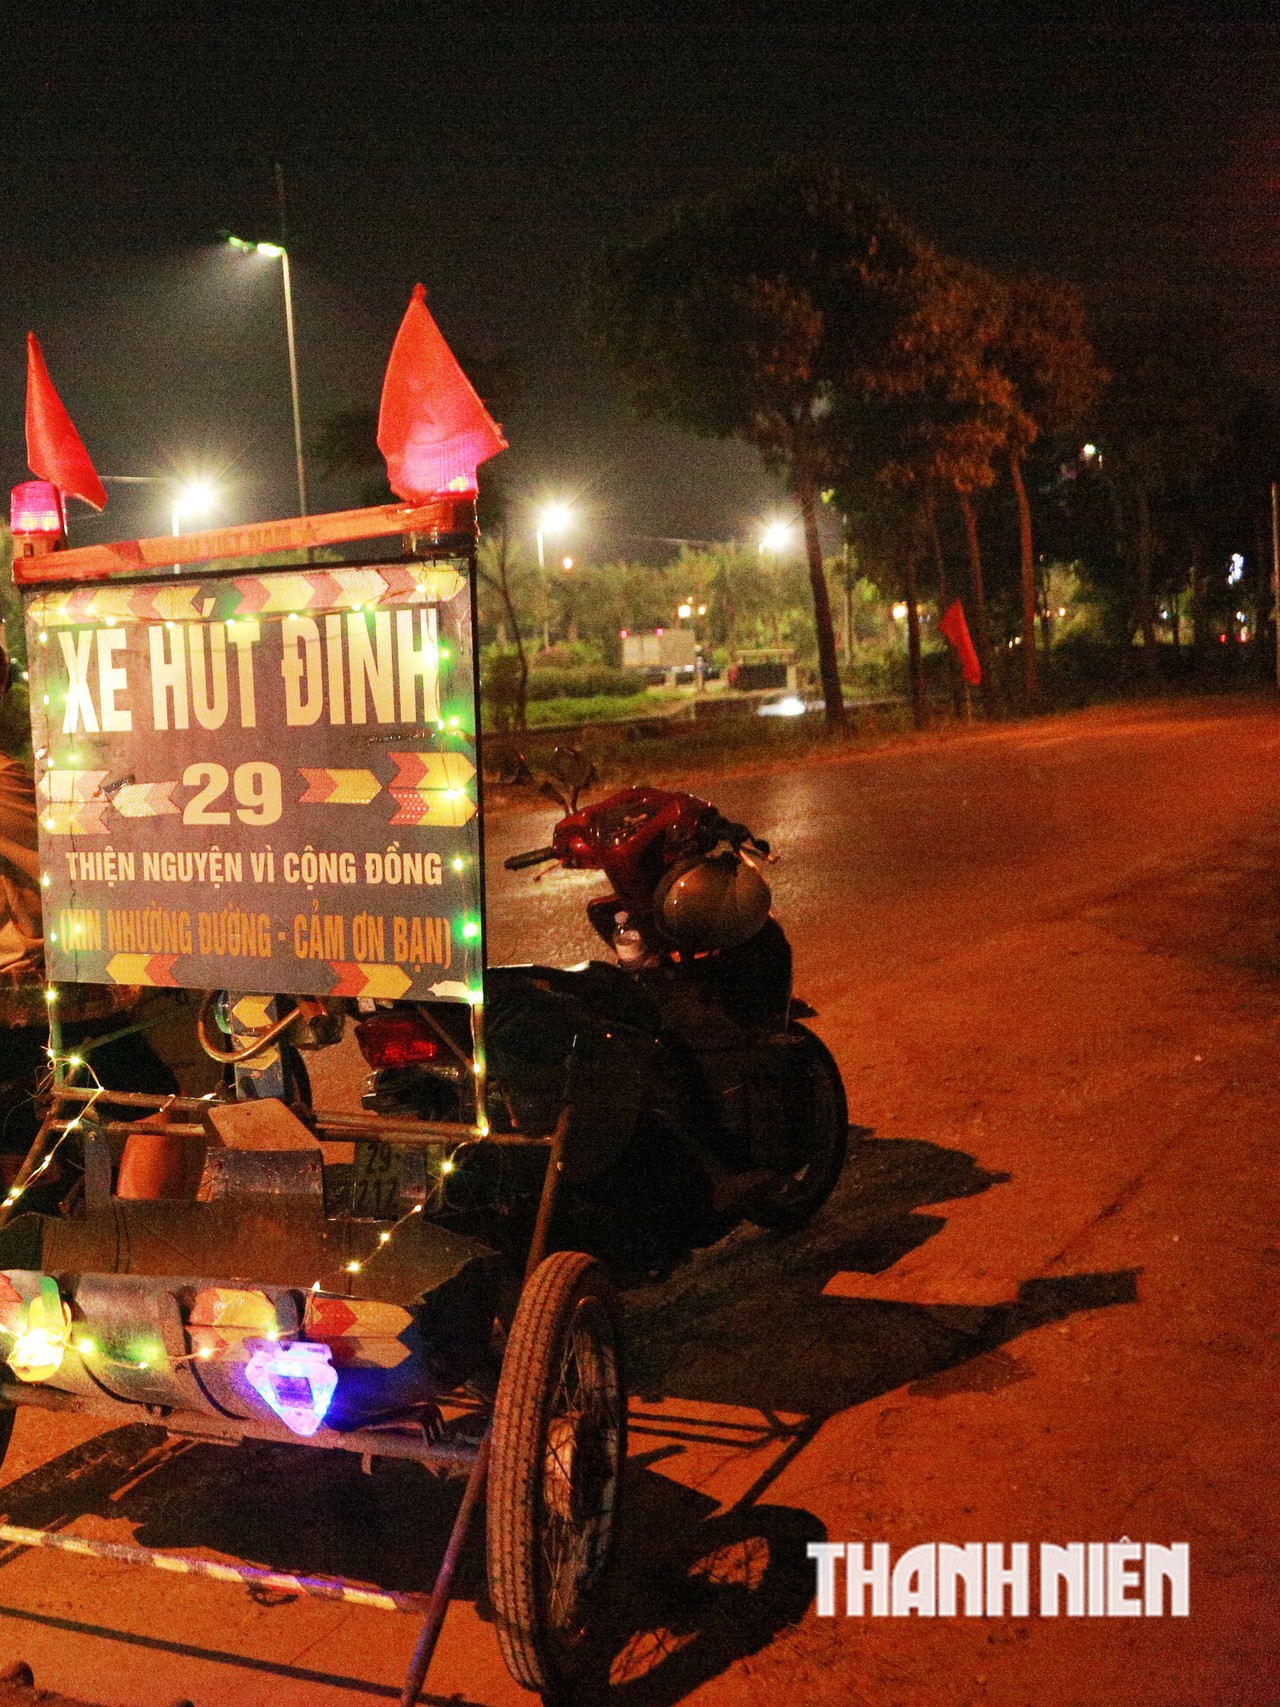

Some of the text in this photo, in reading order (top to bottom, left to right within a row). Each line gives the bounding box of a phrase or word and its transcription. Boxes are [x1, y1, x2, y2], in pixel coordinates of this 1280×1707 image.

[57, 597, 440, 734] XE HÚT ĐINH
[182, 761, 283, 826] 29
[66, 841, 443, 891] THIỆN NGUYỆN VÌ CỘNG ĐỒNG
[60, 908, 102, 954] (XIN
[107, 900, 192, 954] NHƯỜNG
[198, 901, 272, 957] ĐƯỜNG
[293, 898, 345, 960] CẢM
[352, 911, 385, 961] ƠN
[393, 915, 452, 972] BẠN)
